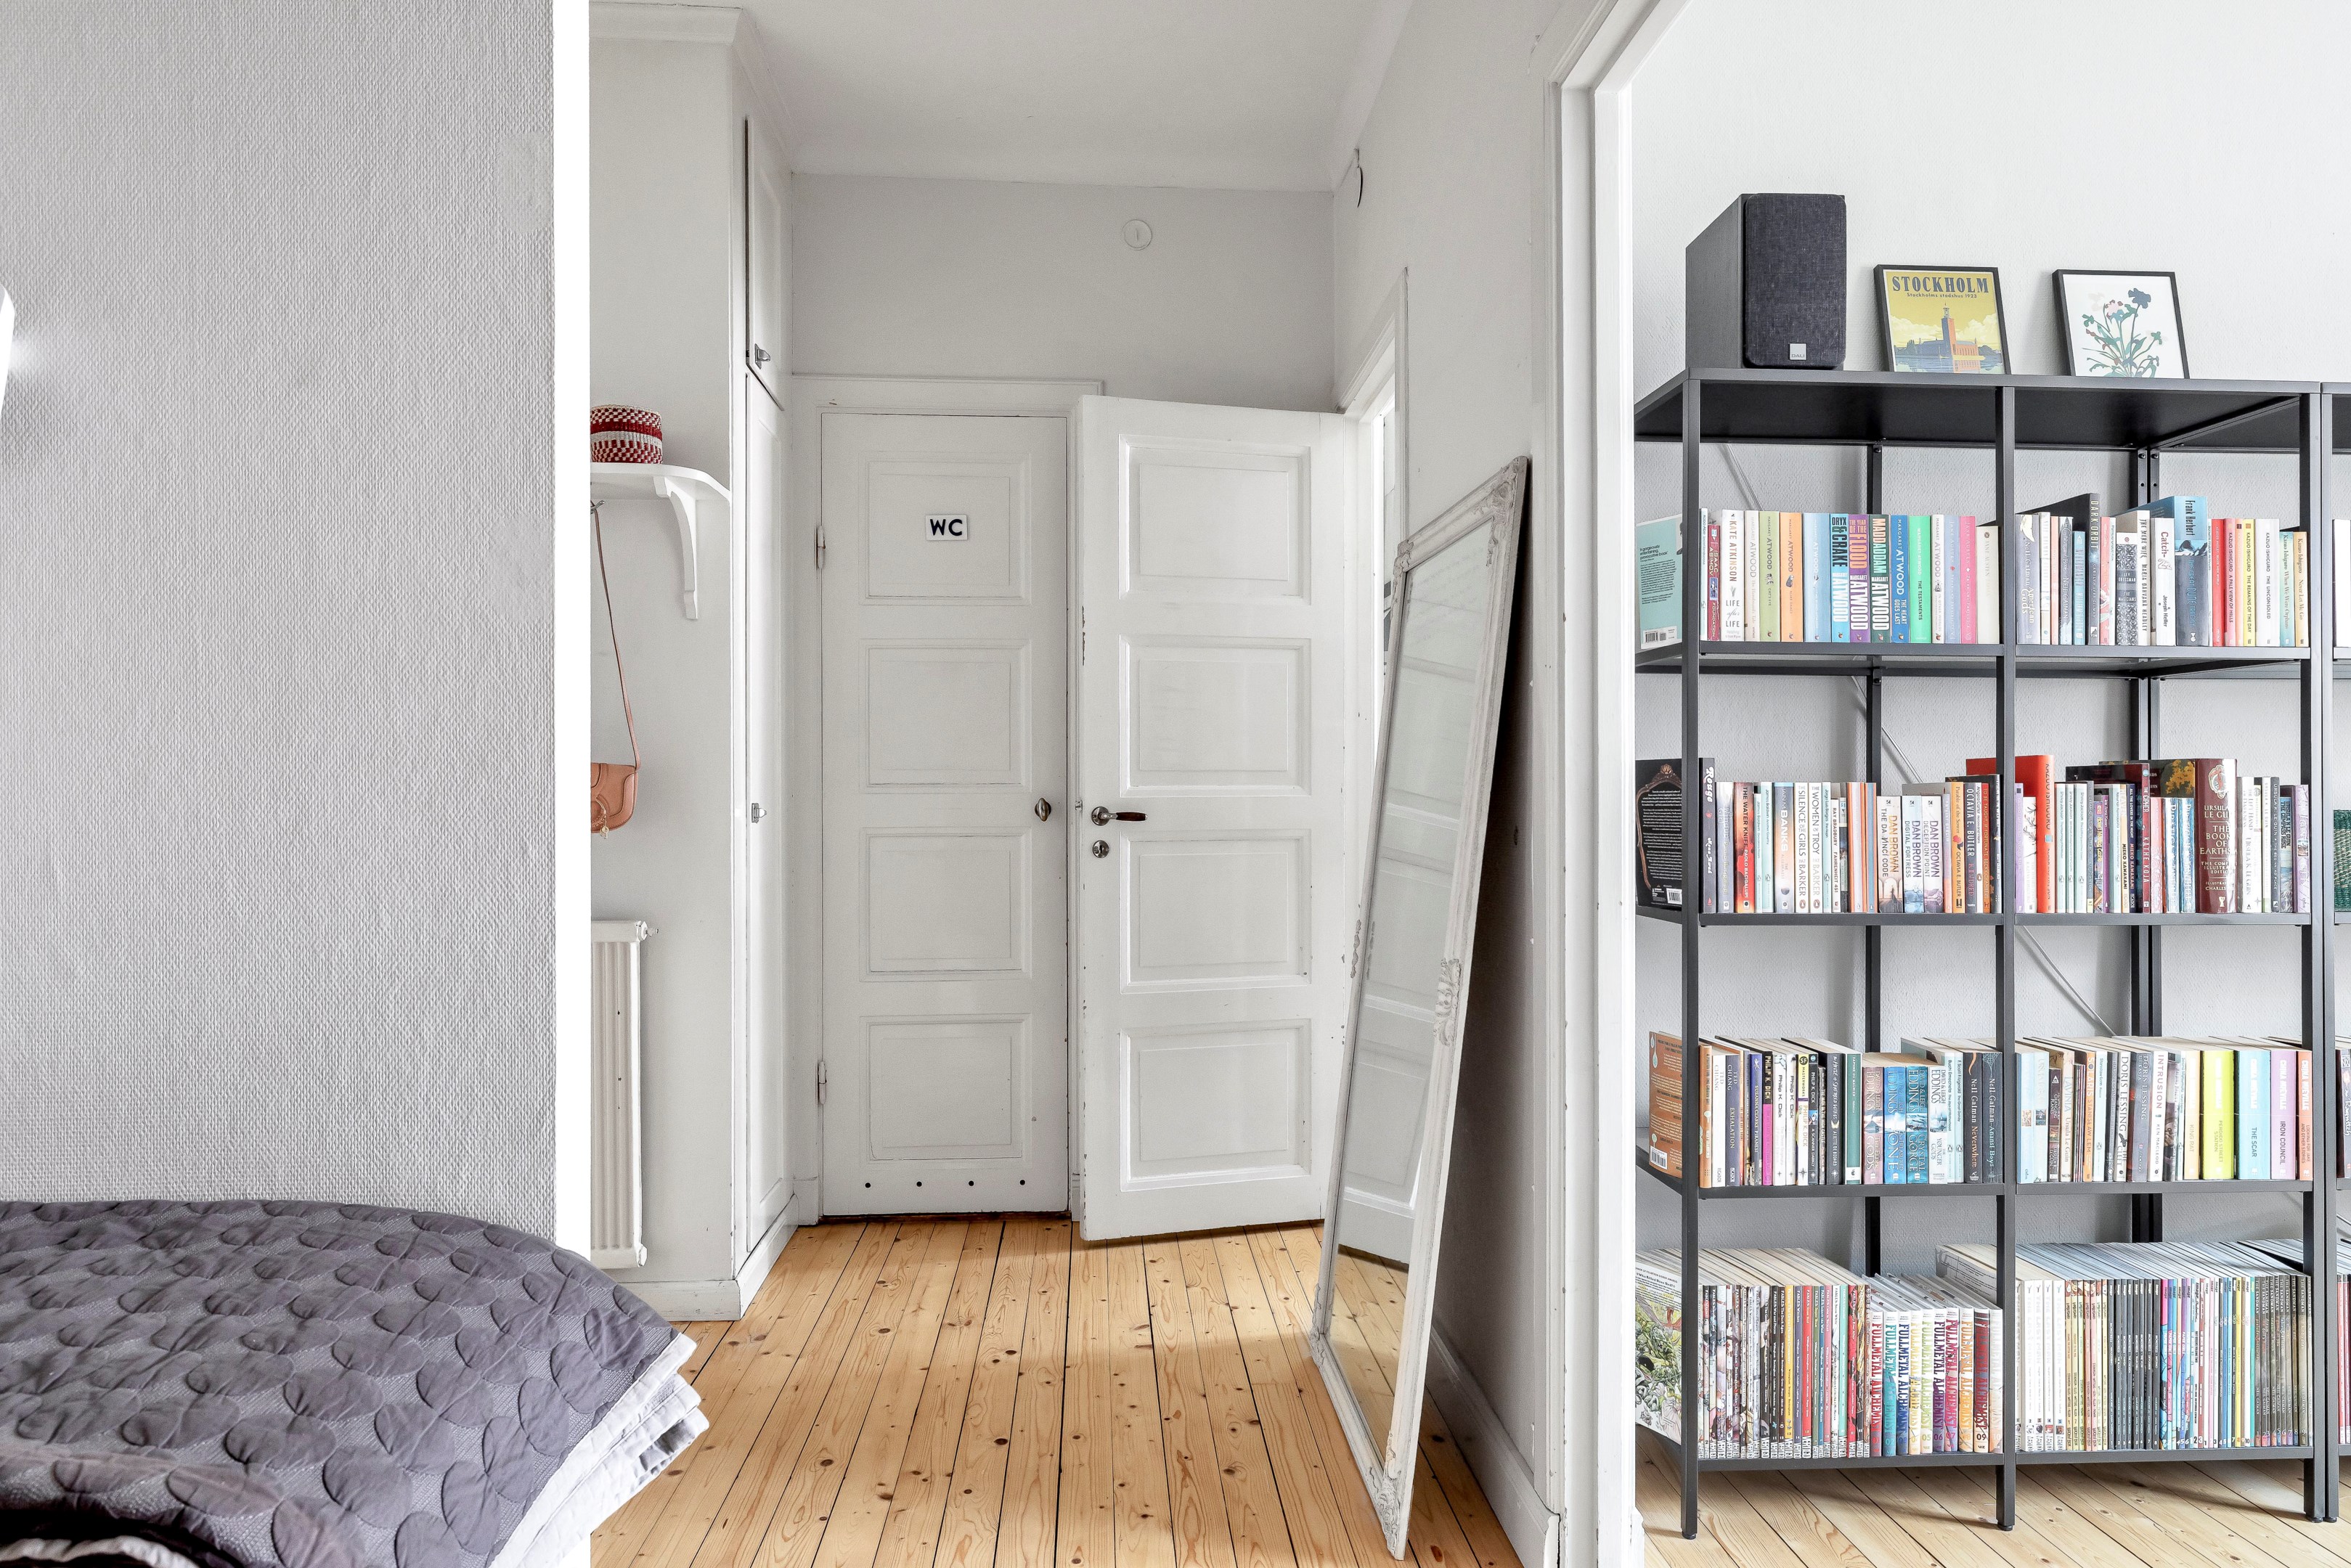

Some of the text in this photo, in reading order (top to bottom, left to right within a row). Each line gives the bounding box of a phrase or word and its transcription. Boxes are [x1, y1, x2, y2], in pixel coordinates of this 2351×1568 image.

[1891, 276, 1989, 293] STOCKHOLM
[930, 519, 962, 536] WC
[2185, 501, 2196, 536] Frank Herbert
[1832, 534, 1847, 566] CRAKE
[1849, 534, 1867, 568] FLOOD
[1873, 518, 1886, 573] MADDADDAM
[1833, 579, 1848, 621] ATWOOD
[1850, 581, 1867, 630] ATWOOD
[1872, 583, 1889, 630] ATWOOD
[1888, 815, 1899, 873] DAN BROWN
[1912, 821, 1922, 877] DAN BROWN
[1930, 821, 1939, 877] DAN BROWN
[1908, 1070, 1919, 1112] EDDINGS
[1931, 1070, 1941, 1103] EDDINGS
[2119, 1056, 2129, 1132] DORIS LESSING
[1888, 1132, 1898, 1171] ONE
[1909, 1135, 1918, 1172] GORGE
[1871, 1323, 1882, 1432] FULLMETAL ALCHEMIST
[1897, 1324, 1909, 1433] FULLMETAL ALCHEMIST
[1933, 1321, 1944, 1430] FULLMETAL ALCHEMIST
[1945, 1320, 1958, 1428] FULLMETAL ALCHEMIST
[1760, 1437, 1770, 1458] VERTIGO
[1802, 1436, 1812, 1458] VERTIGO
